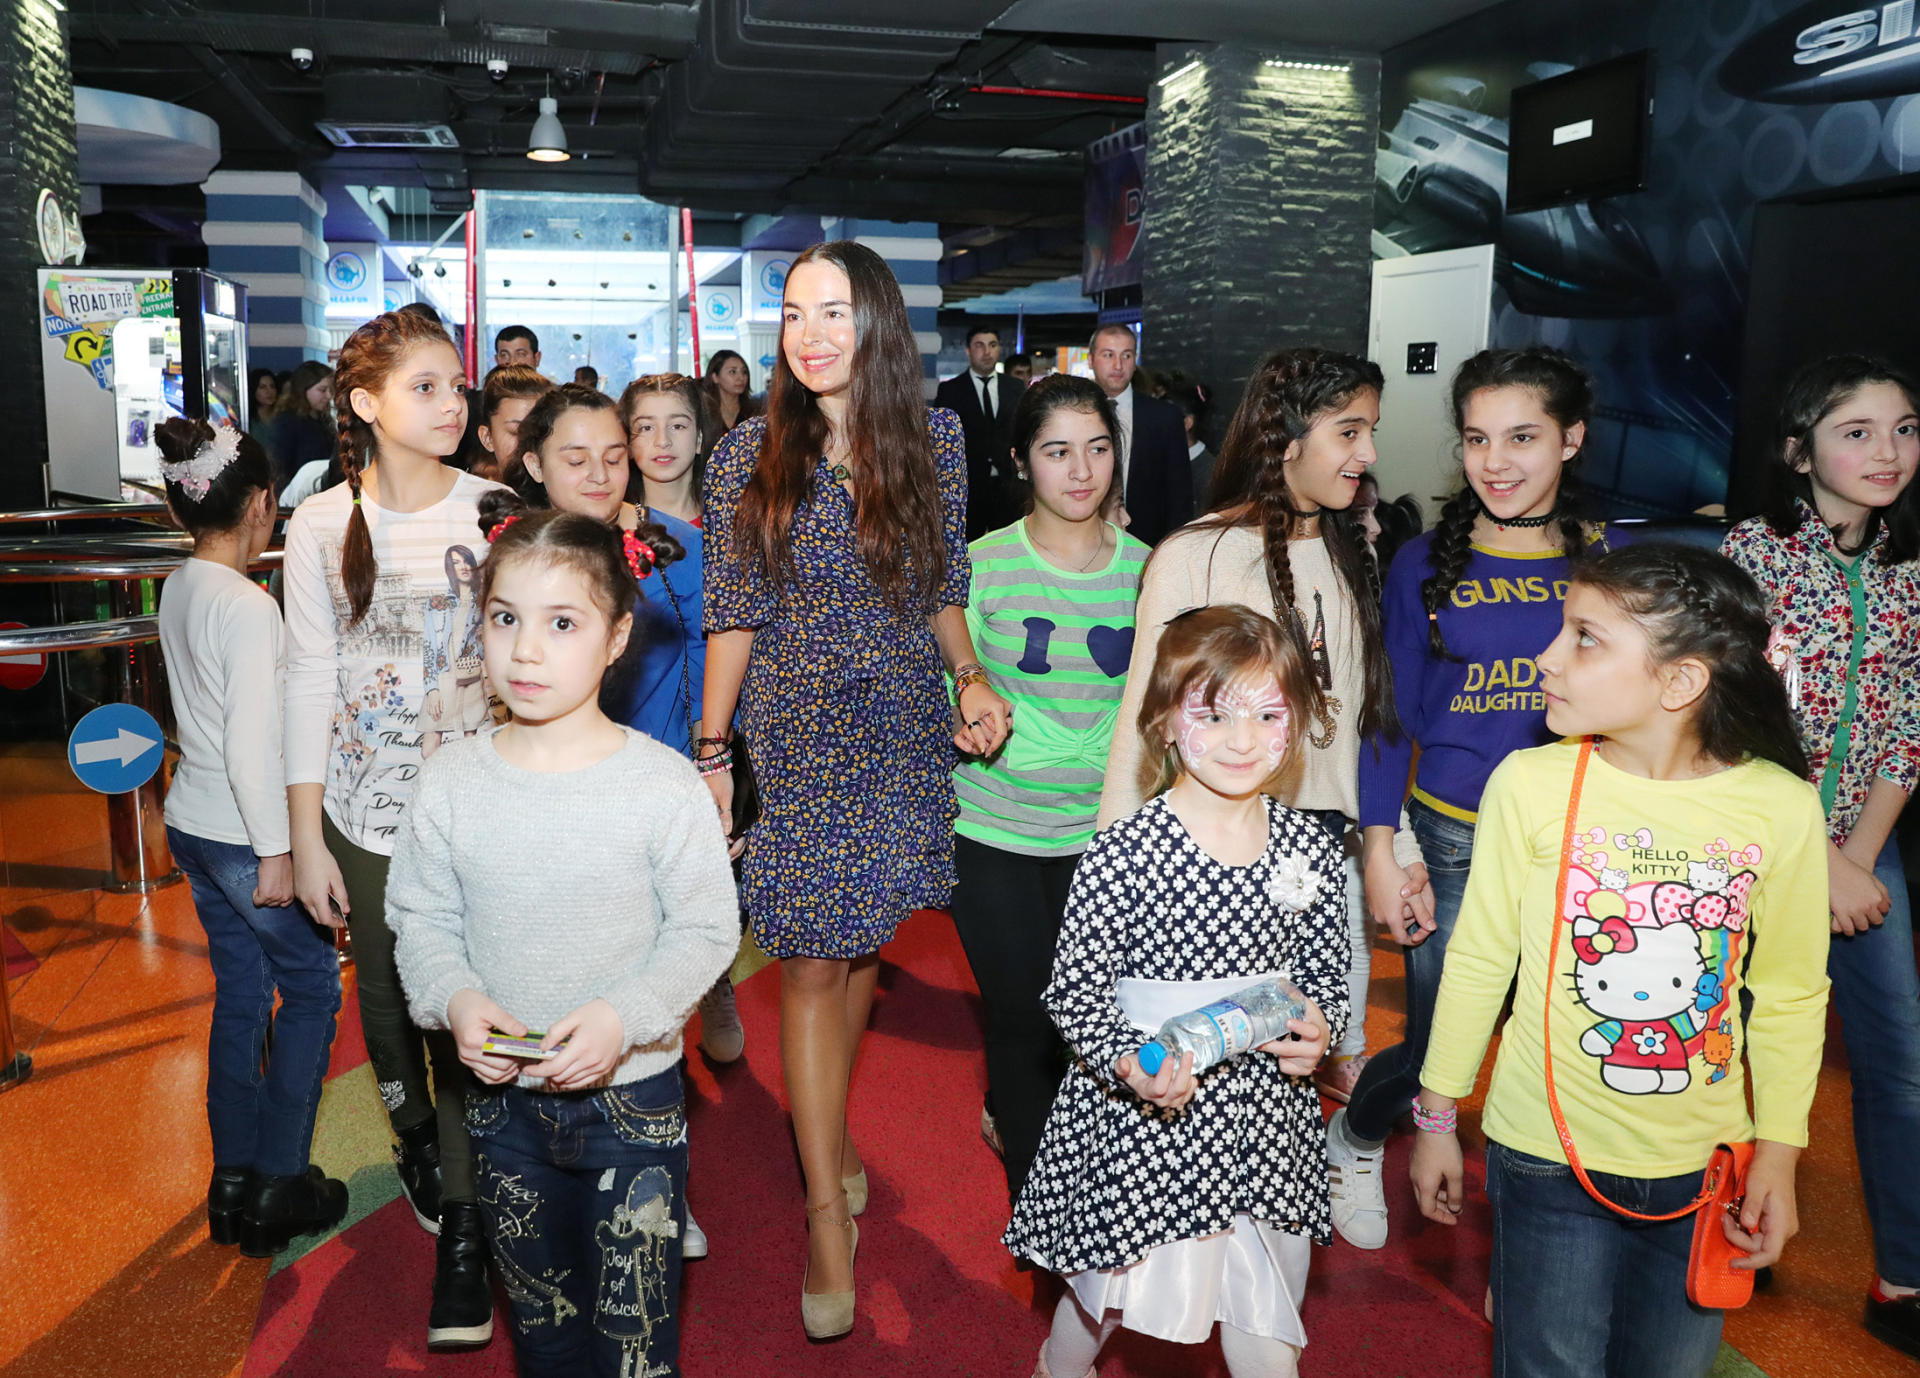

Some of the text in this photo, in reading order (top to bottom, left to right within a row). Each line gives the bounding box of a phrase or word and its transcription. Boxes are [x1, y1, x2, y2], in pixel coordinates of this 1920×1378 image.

[1793, 0, 1920, 65] SI
[69, 292, 133, 315] ROAD TRIP
[143, 292, 174, 304] FREEWA
[1450, 576, 1550, 608] GUNS
[1017, 617, 1056, 675] I
[1463, 657, 1541, 692] DAD
[388, 708, 419, 725] Happ
[370, 792, 406, 814] Day
[1632, 849, 1689, 862] HELLO
[1632, 864, 1680, 877] KITTY
[607, 1246, 633, 1275] Joy
[610, 1277, 626, 1296] of
